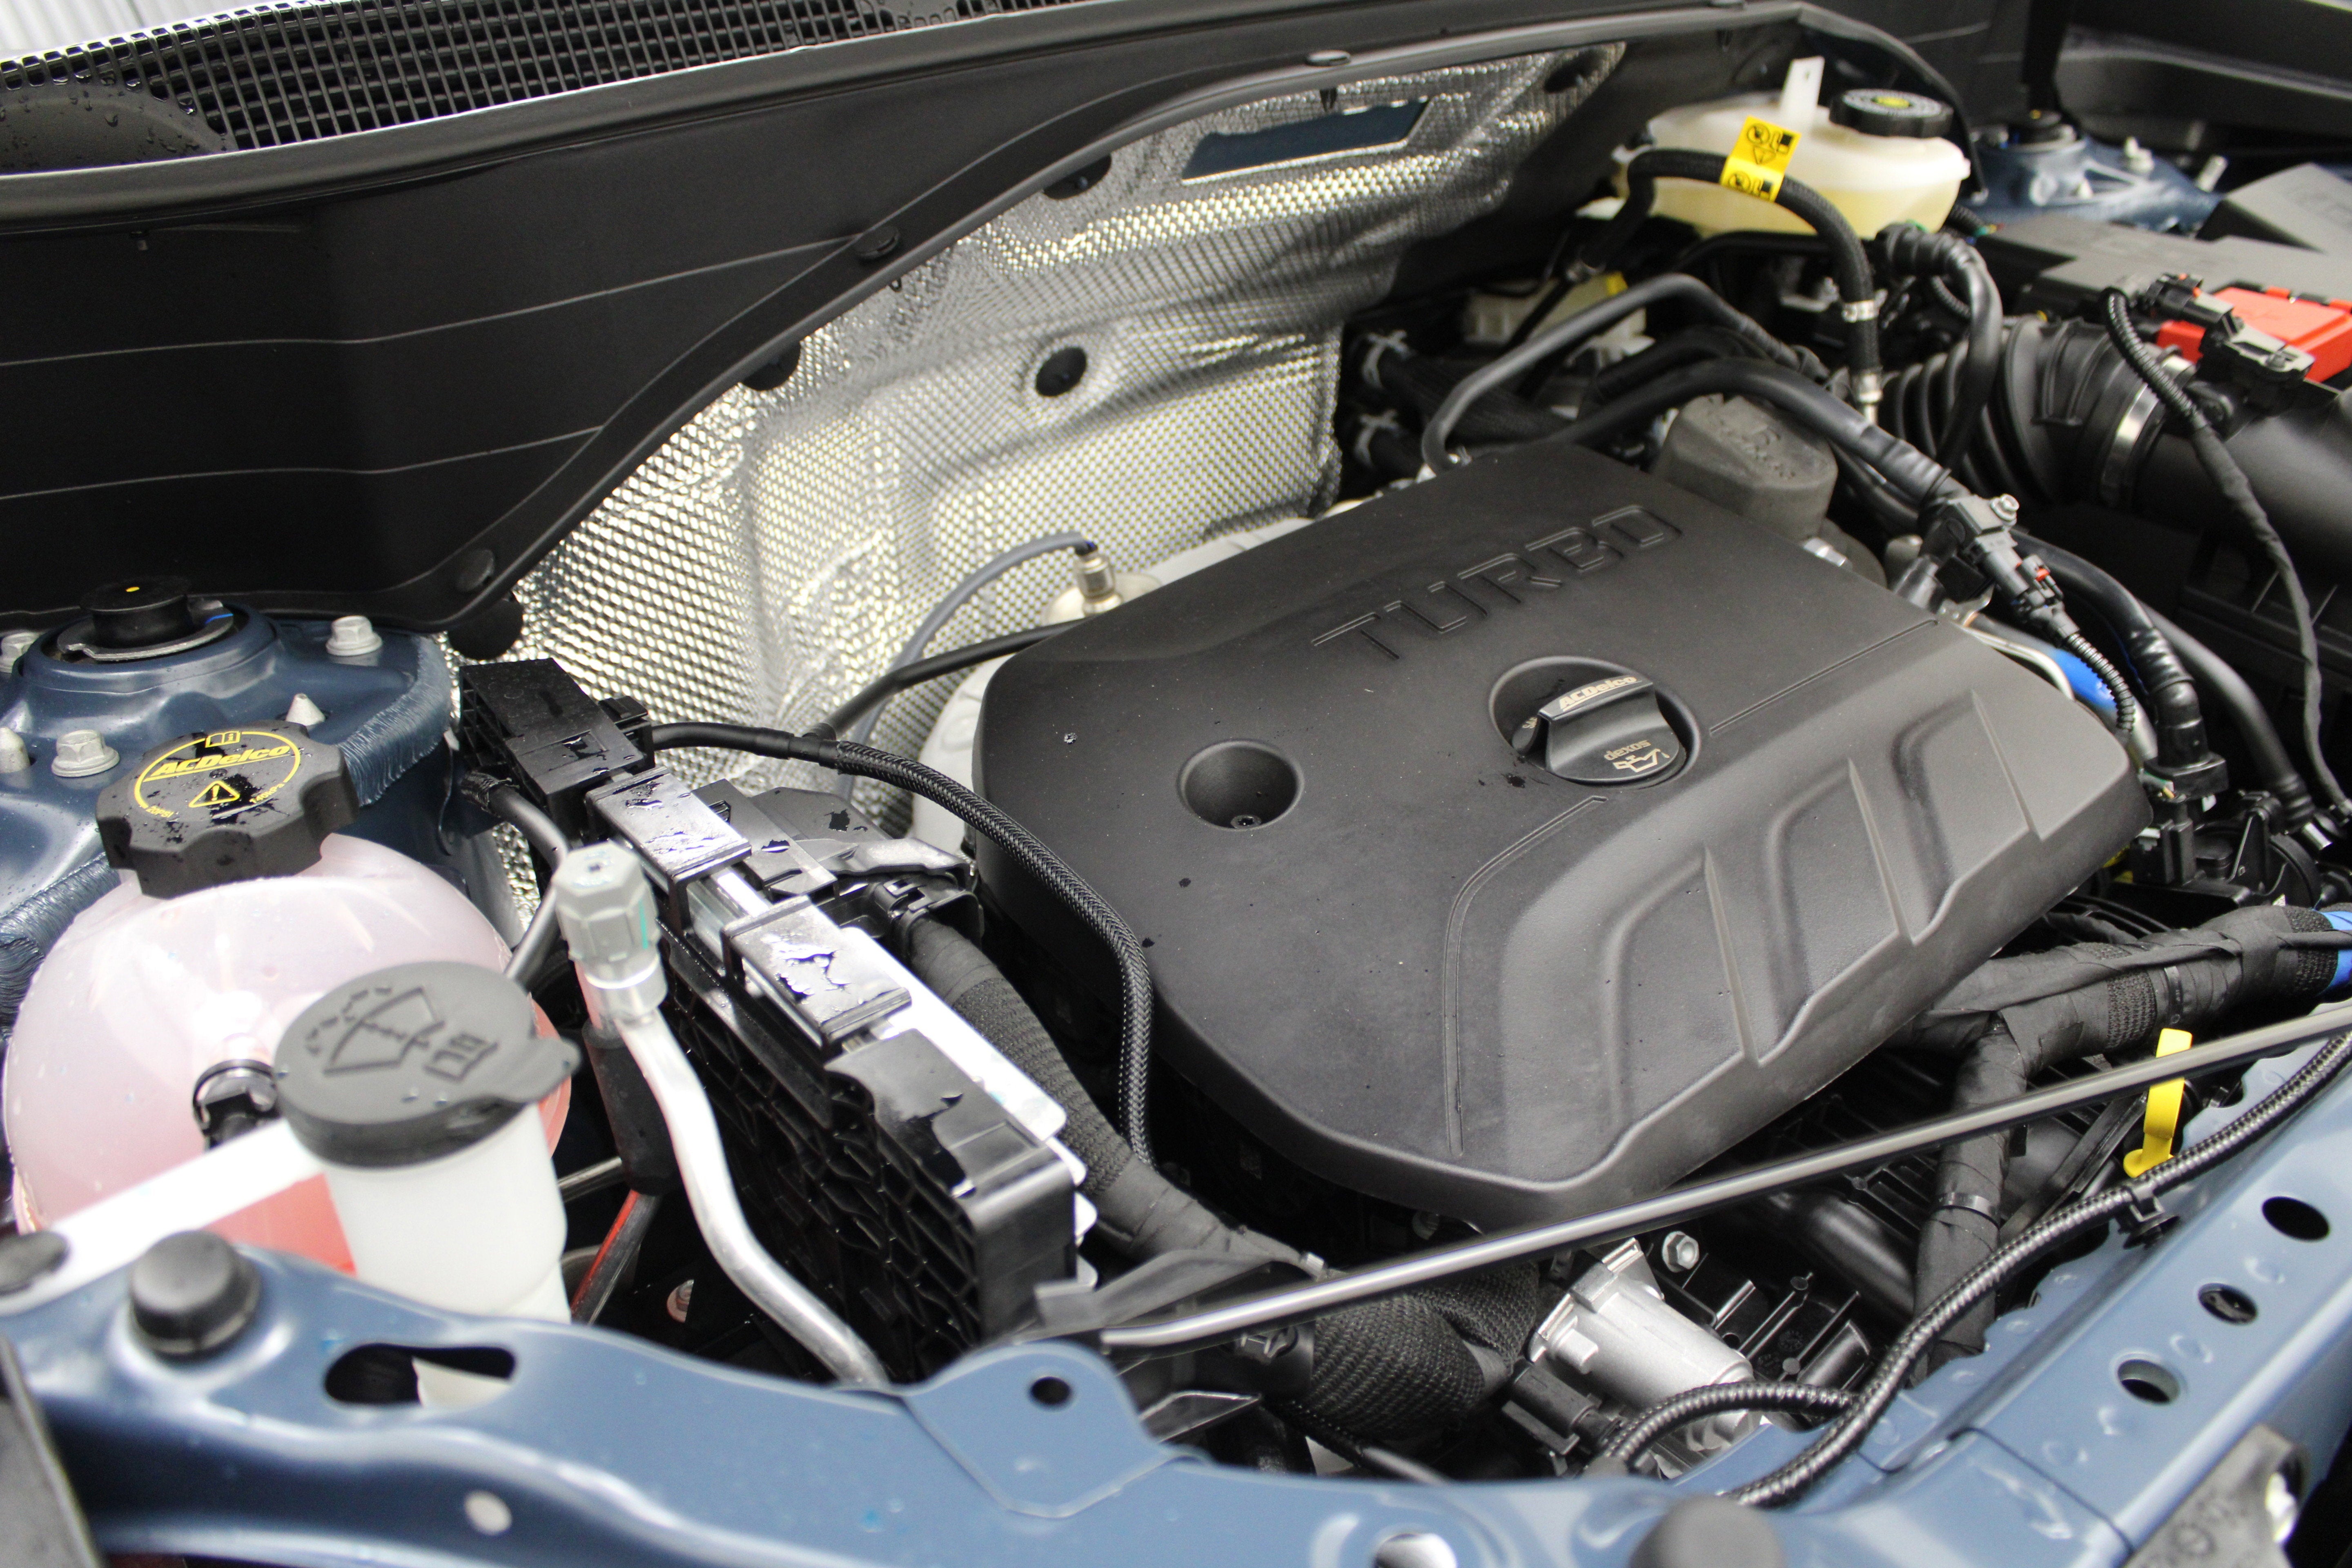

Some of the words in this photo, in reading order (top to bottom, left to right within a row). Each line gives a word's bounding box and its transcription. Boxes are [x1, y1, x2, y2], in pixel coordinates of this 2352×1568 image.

[1311, 505, 1682, 659] TURBO
[1559, 676, 1637, 710] ACDelco
[151, 746, 290, 777] ACDelco
[1604, 740, 1651, 760] dexos
[146, 805, 174, 818] 20PSI
